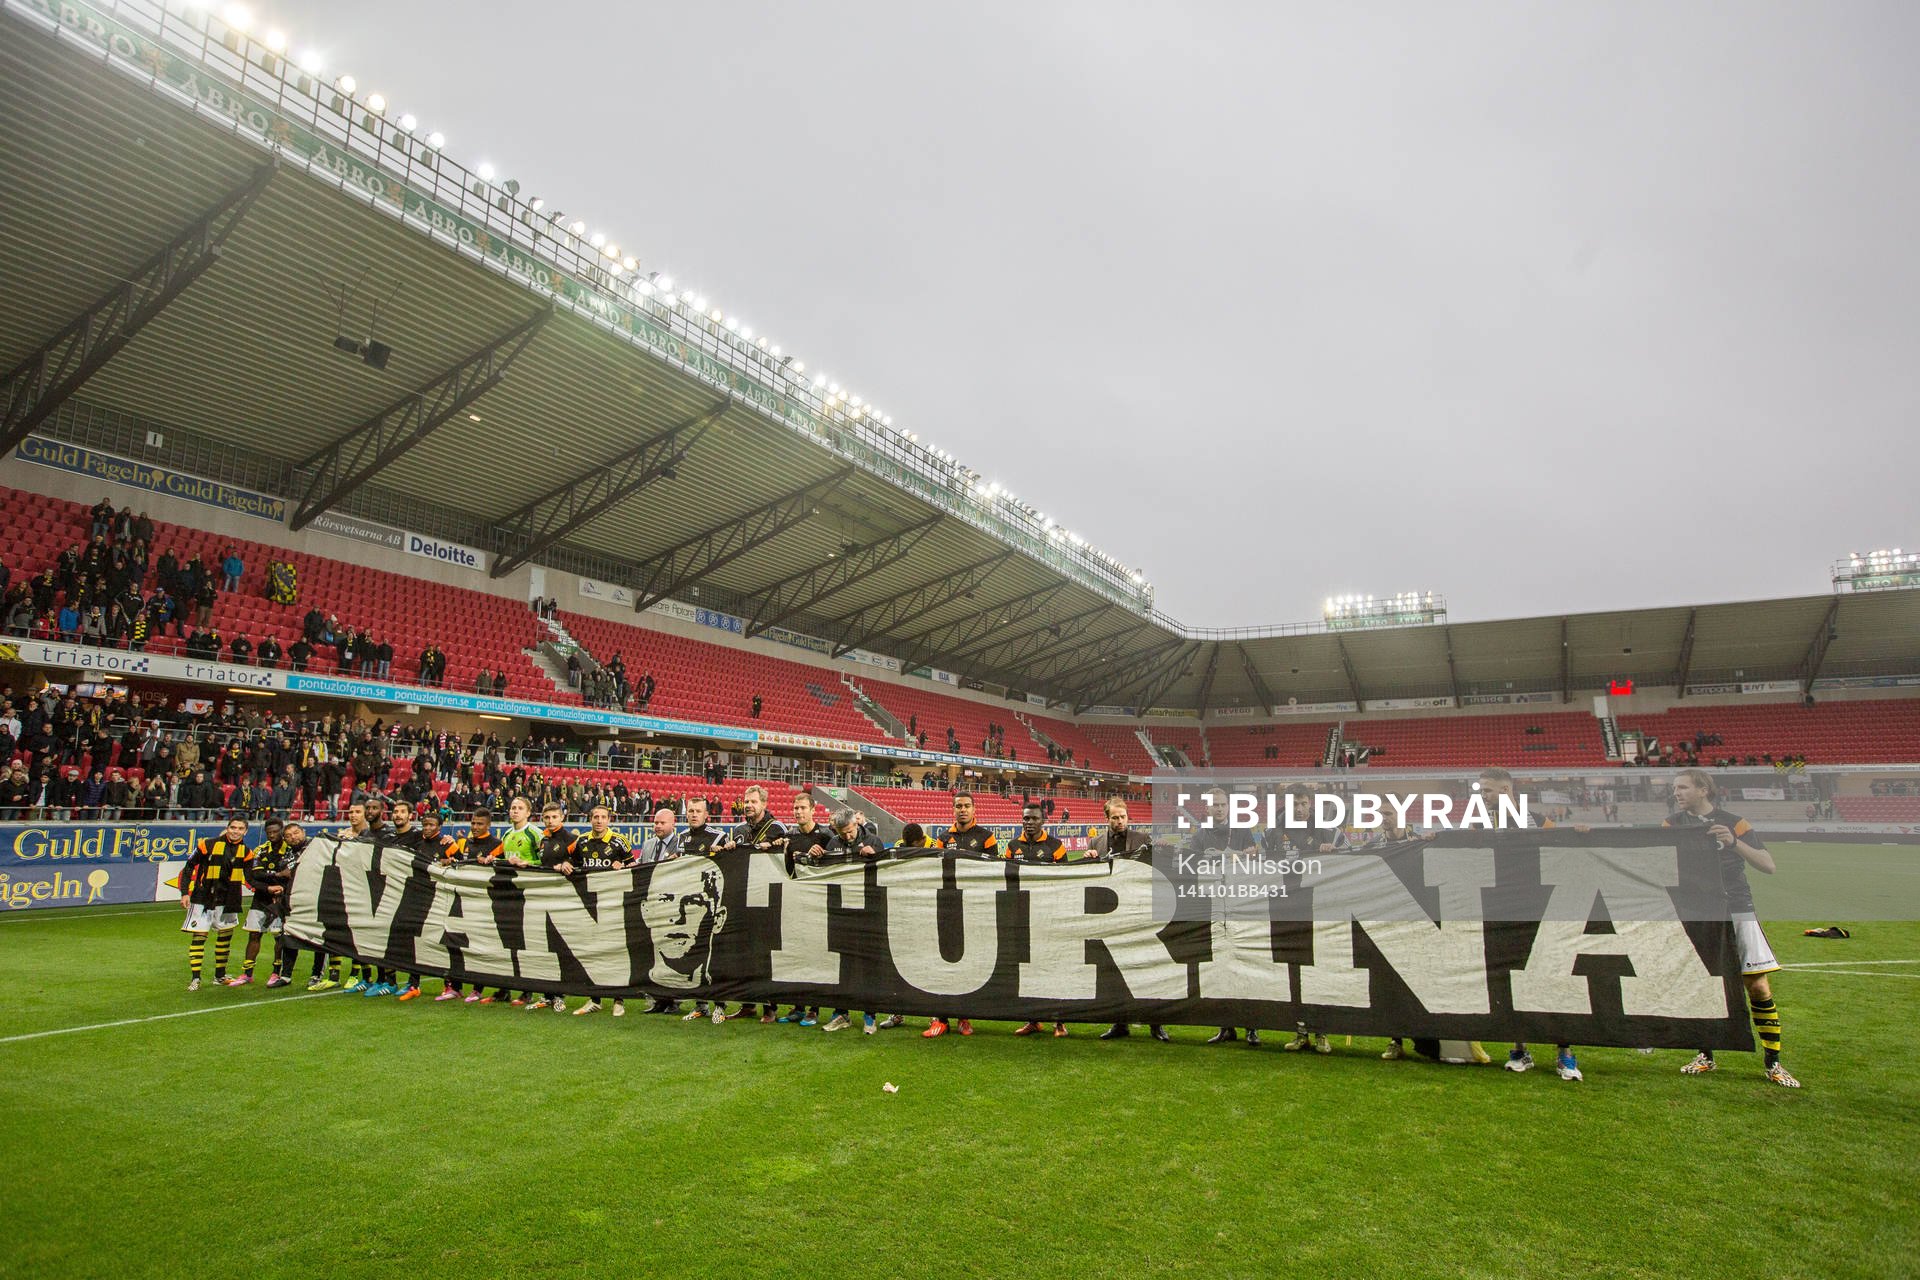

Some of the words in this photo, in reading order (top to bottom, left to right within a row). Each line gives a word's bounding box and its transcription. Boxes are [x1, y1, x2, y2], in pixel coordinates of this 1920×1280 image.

[179, 73, 269, 135] ÅBRO
[312, 144, 385, 196] ÅBRO
[413, 199, 474, 245] ÅBRO
[498, 246, 550, 287] ÅBRO
[638, 324, 679, 356] ÅBRO
[20, 437, 78, 468] Guld
[83, 450, 152, 484] Fågeln
[166, 475, 214, 500] Guld
[217, 486, 273, 517] Fågeln
[313, 515, 383, 542] Rörsvetsarna
[384, 534, 401, 546] AB
[42, 646, 132, 671] triator
[184, 662, 258, 685] triator
[298, 677, 387, 698] pontuzlofgren.se
[394, 689, 470, 707] pontuzlofgren.se
[475, 698, 542, 717] pontuzlofgren.se
[546, 707, 605, 723] pontuzlofgren.se
[13, 829, 104, 860] Guld
[284, 837, 634, 987] IVAN
[747, 847, 1729, 1019] TURINA
